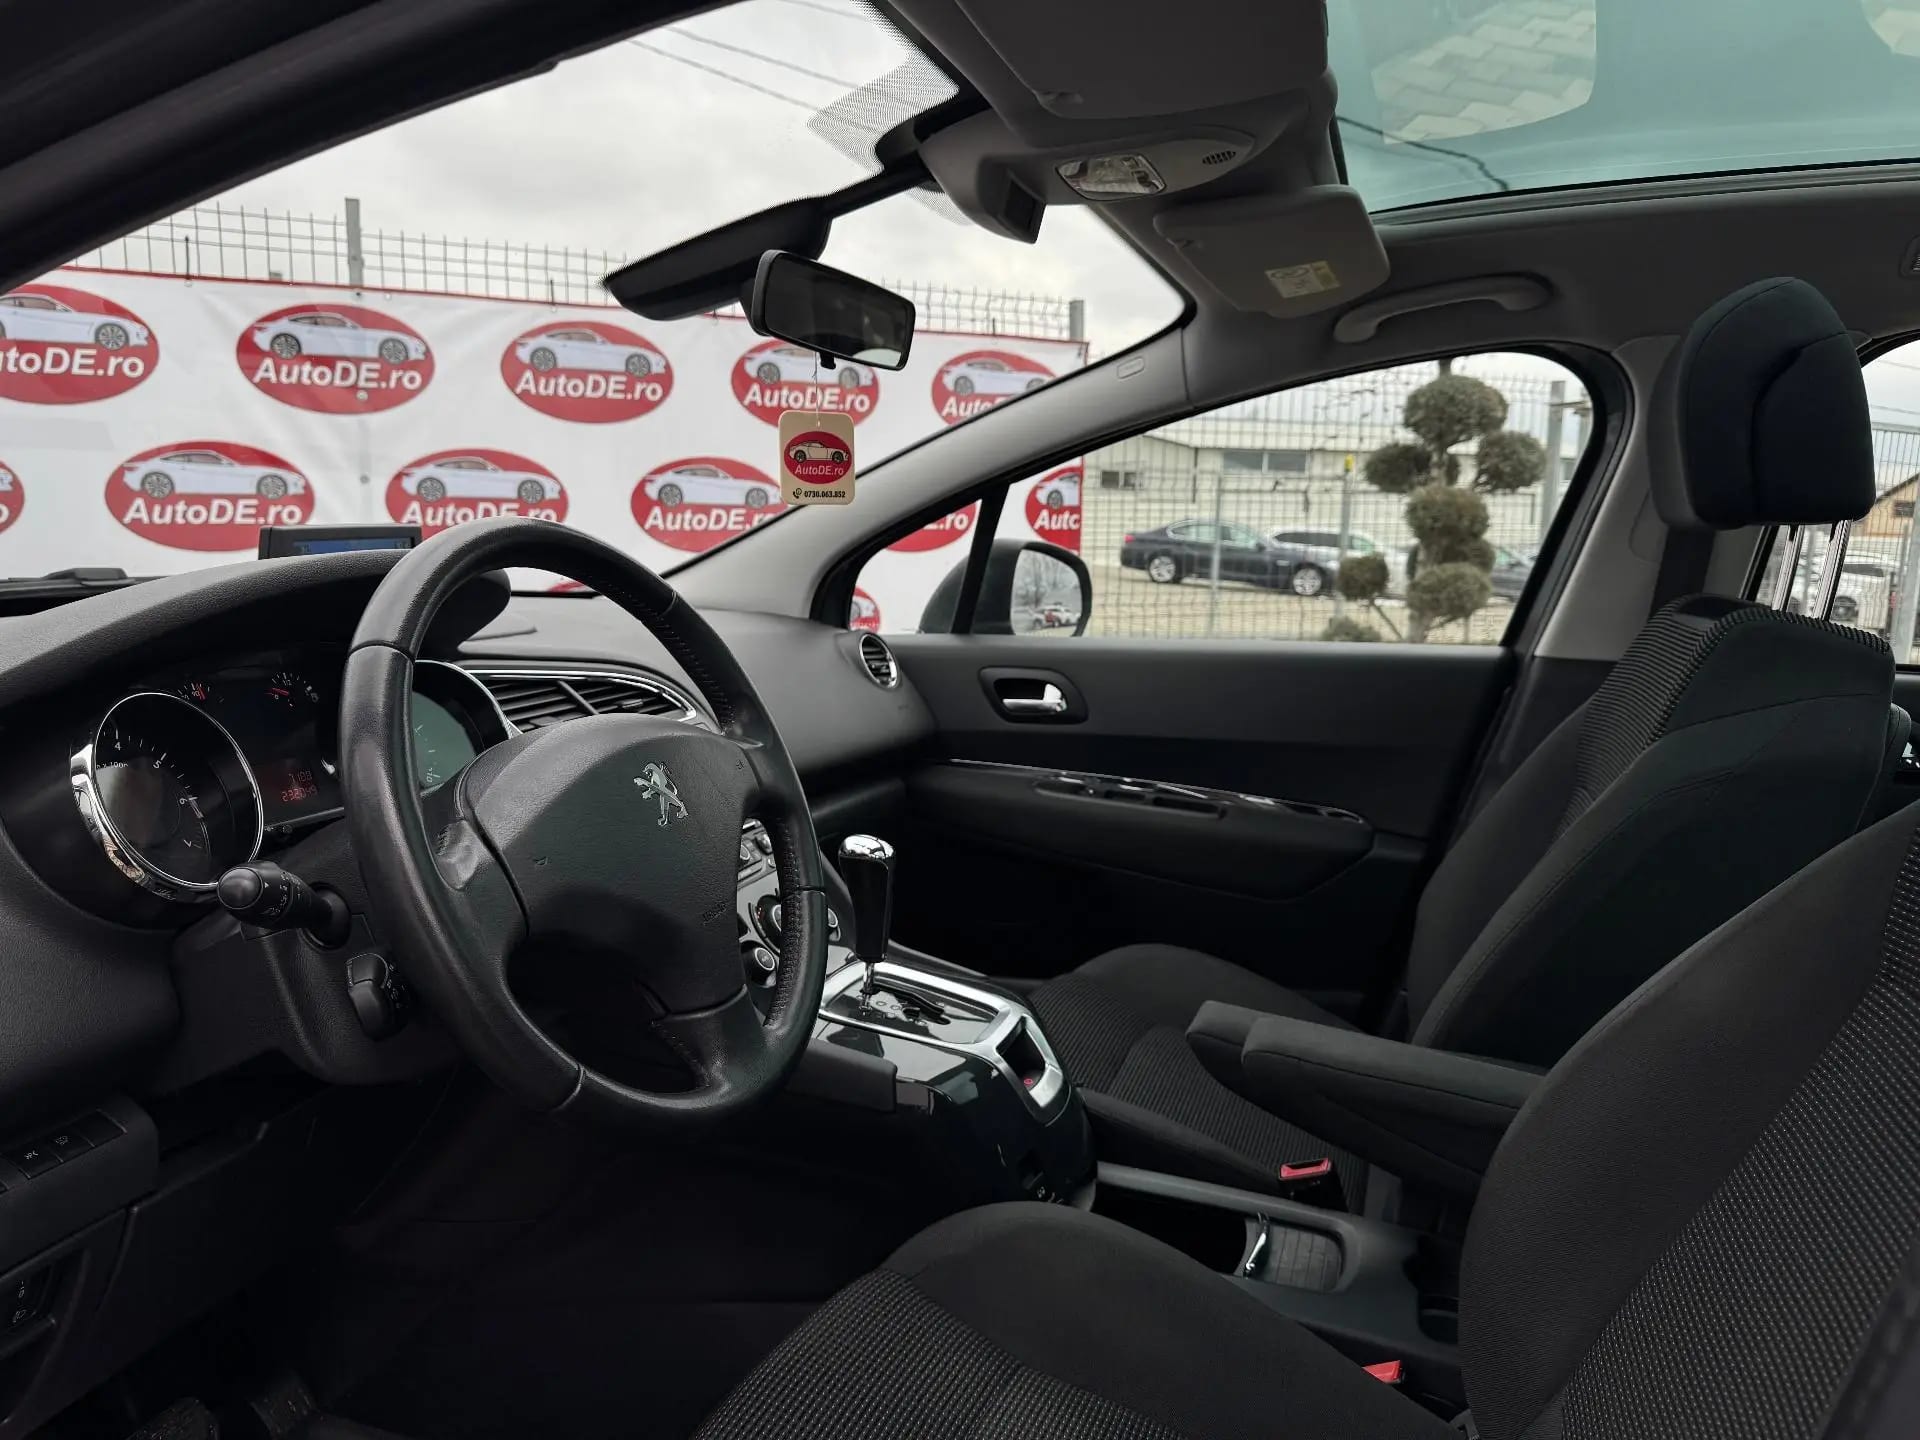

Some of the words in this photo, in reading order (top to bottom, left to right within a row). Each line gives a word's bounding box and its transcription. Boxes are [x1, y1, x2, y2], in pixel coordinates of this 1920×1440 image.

[0, 346, 145, 378] toDE.ro
[253, 357, 423, 391] AutoDE.ro
[515, 374, 662, 401] AutoDE.ro
[743, 384, 870, 413] AutoDE.ro
[795, 464, 844, 475] AutoDE.ro
[122, 497, 303, 526] AutoDE.ro
[114, 741, 122, 751] 4
[153, 760, 162, 769] 5
[179, 797, 188, 805] 6
[183, 839, 192, 848] 7
